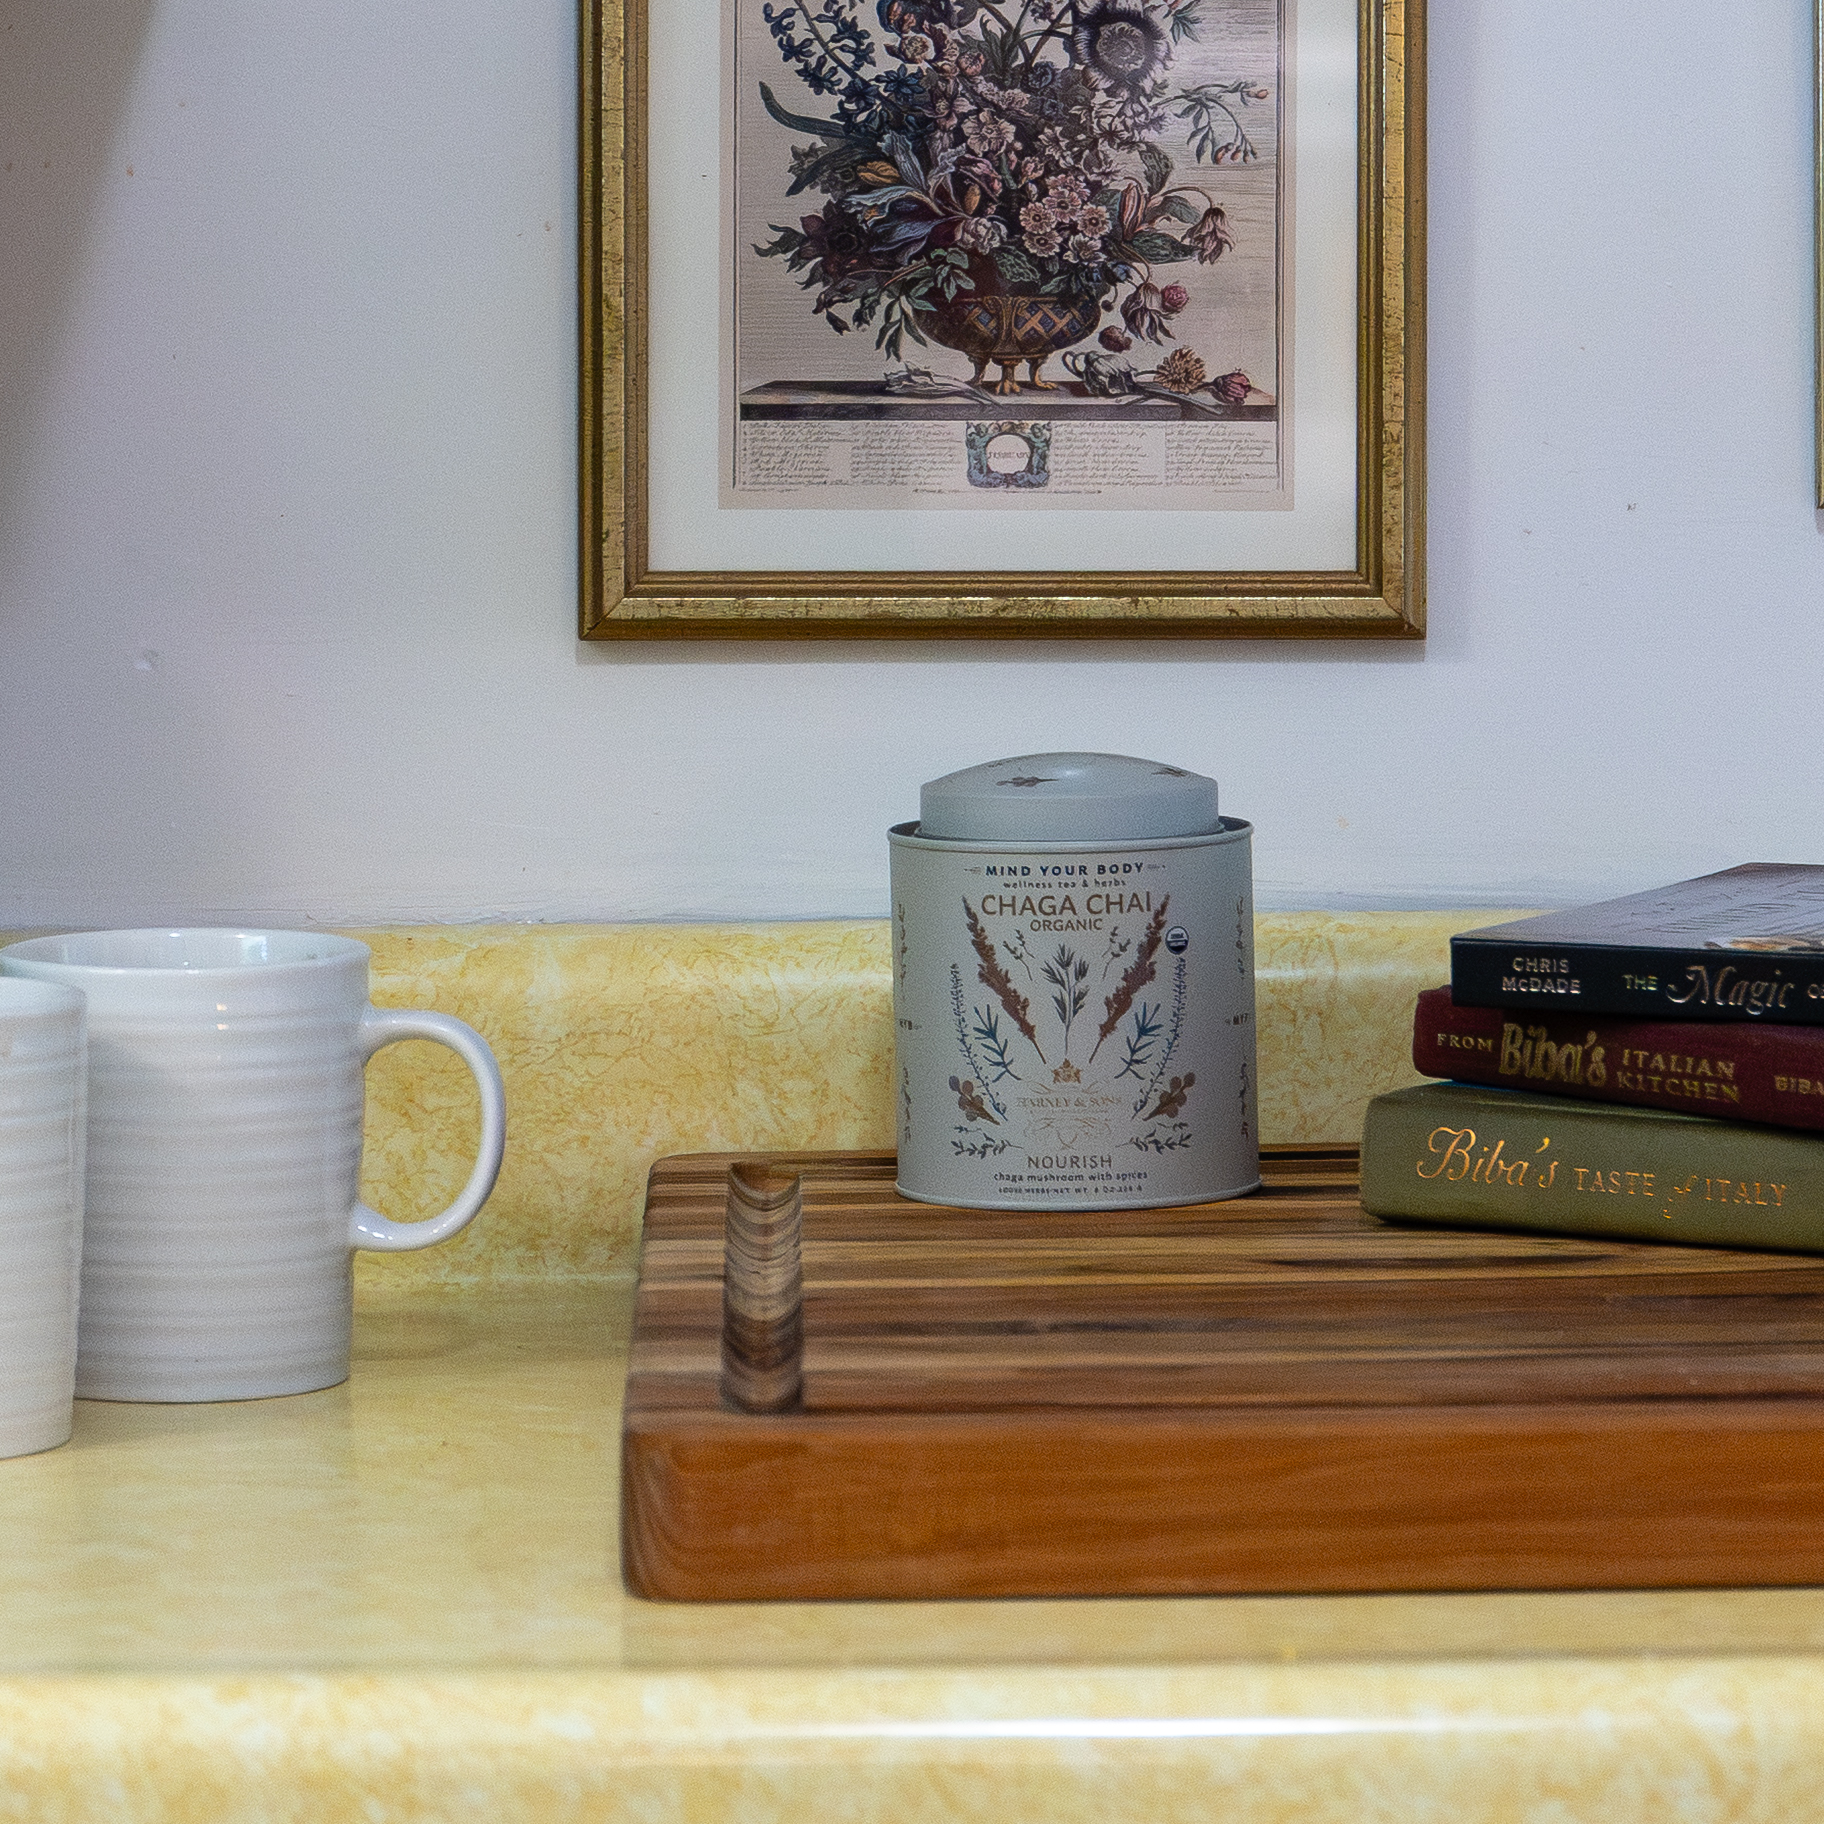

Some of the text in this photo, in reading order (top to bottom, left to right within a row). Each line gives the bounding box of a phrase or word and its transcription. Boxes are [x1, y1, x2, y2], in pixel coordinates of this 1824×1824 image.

[985, 862, 1144, 877] MIND YOUR BODY
[1003, 878, 1127, 889] wellness tea & herbs
[981, 891, 1152, 916] CHAGA CHAI
[1030, 918, 1103, 932] ORGANIC
[1512, 957, 1570, 974] CHRIS
[1623, 974, 1659, 992] THE
[1666, 965, 1795, 1016] Magic
[1436, 1023, 1608, 1088] FROM Biba's
[1622, 1049, 1737, 1080] ITALIAN
[1616, 1071, 1741, 1105] KITCHEN
[1027, 1155, 1113, 1169] NOURISH
[993, 1171, 1149, 1183] chaga mushroom with spices
[1416, 1126, 1788, 1220] Biba's TASTE of ITALY
